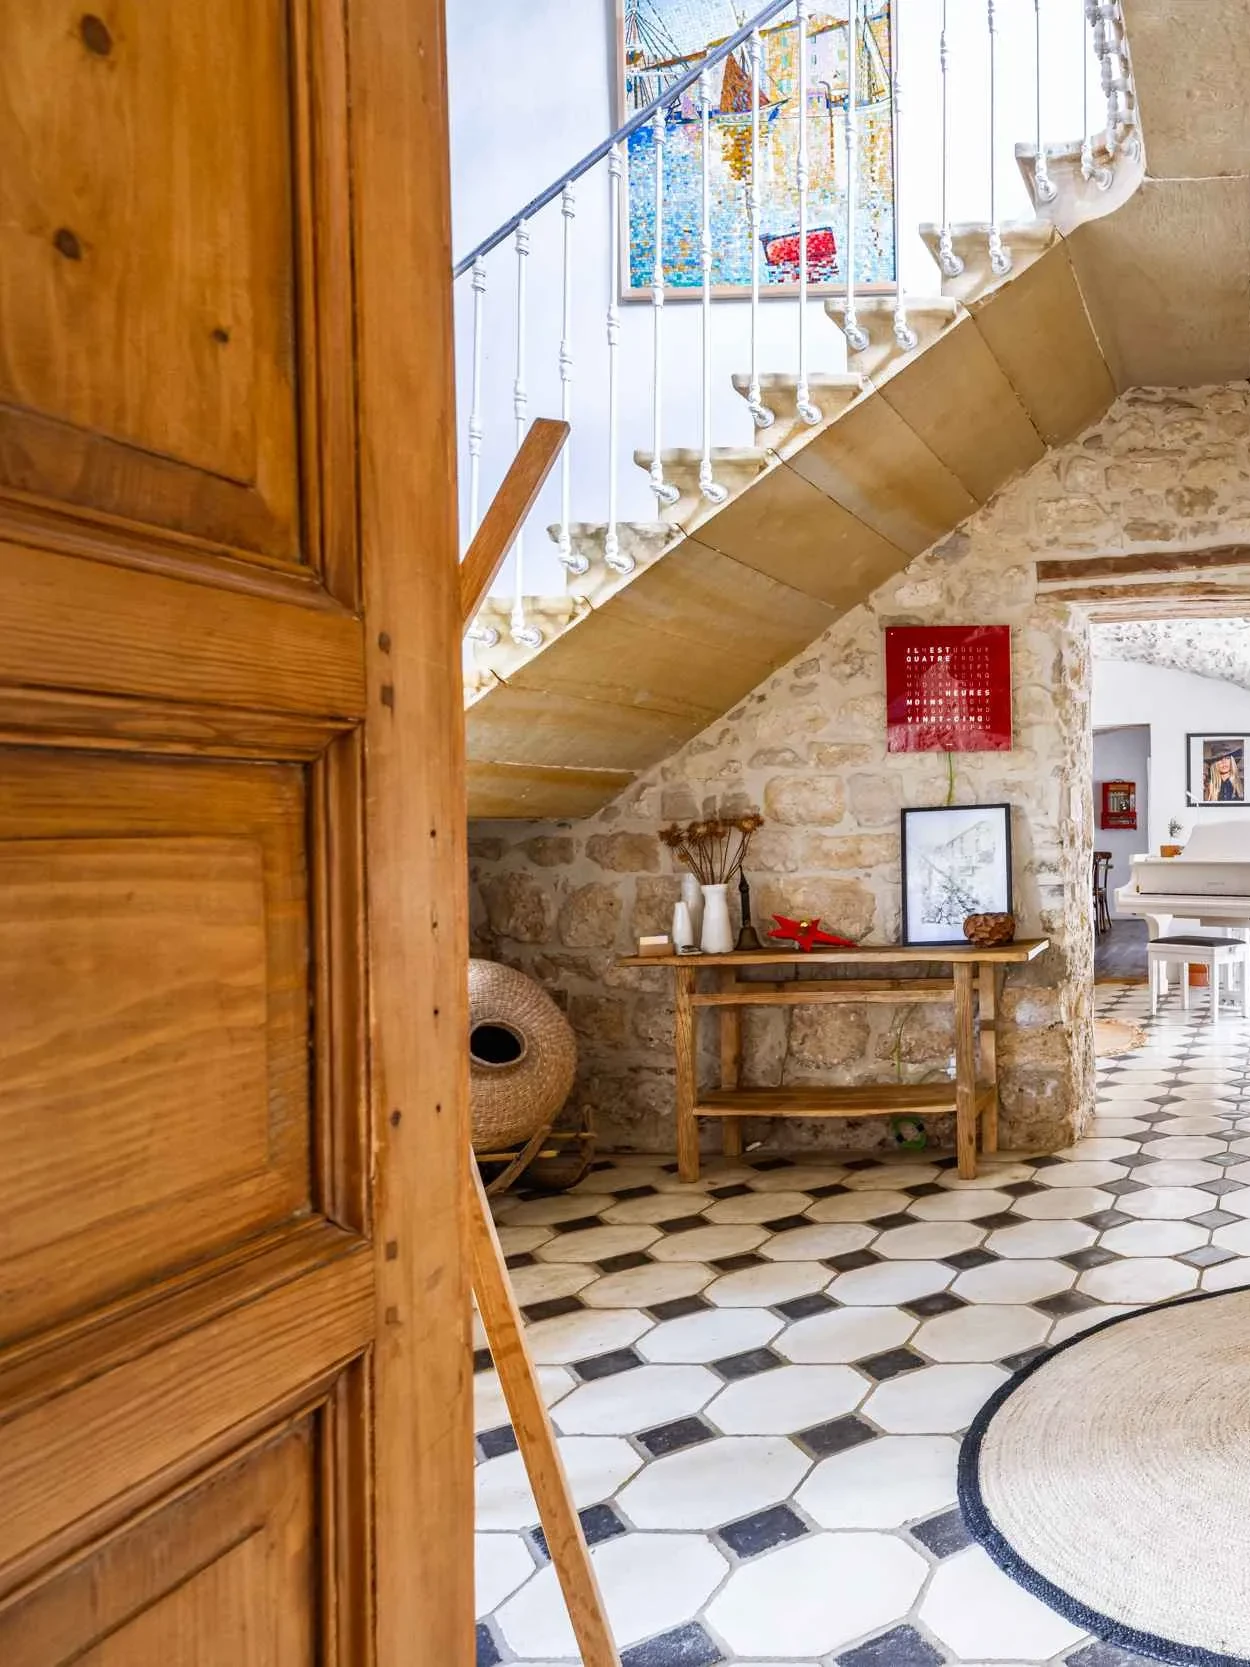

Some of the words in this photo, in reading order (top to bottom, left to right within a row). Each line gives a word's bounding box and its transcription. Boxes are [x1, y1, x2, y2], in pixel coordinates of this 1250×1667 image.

[929, 646, 951, 654] EST
[906, 655, 951, 663] QUATRE
[945, 689, 990, 697] HEURES
[906, 698, 943, 706] MOINS
